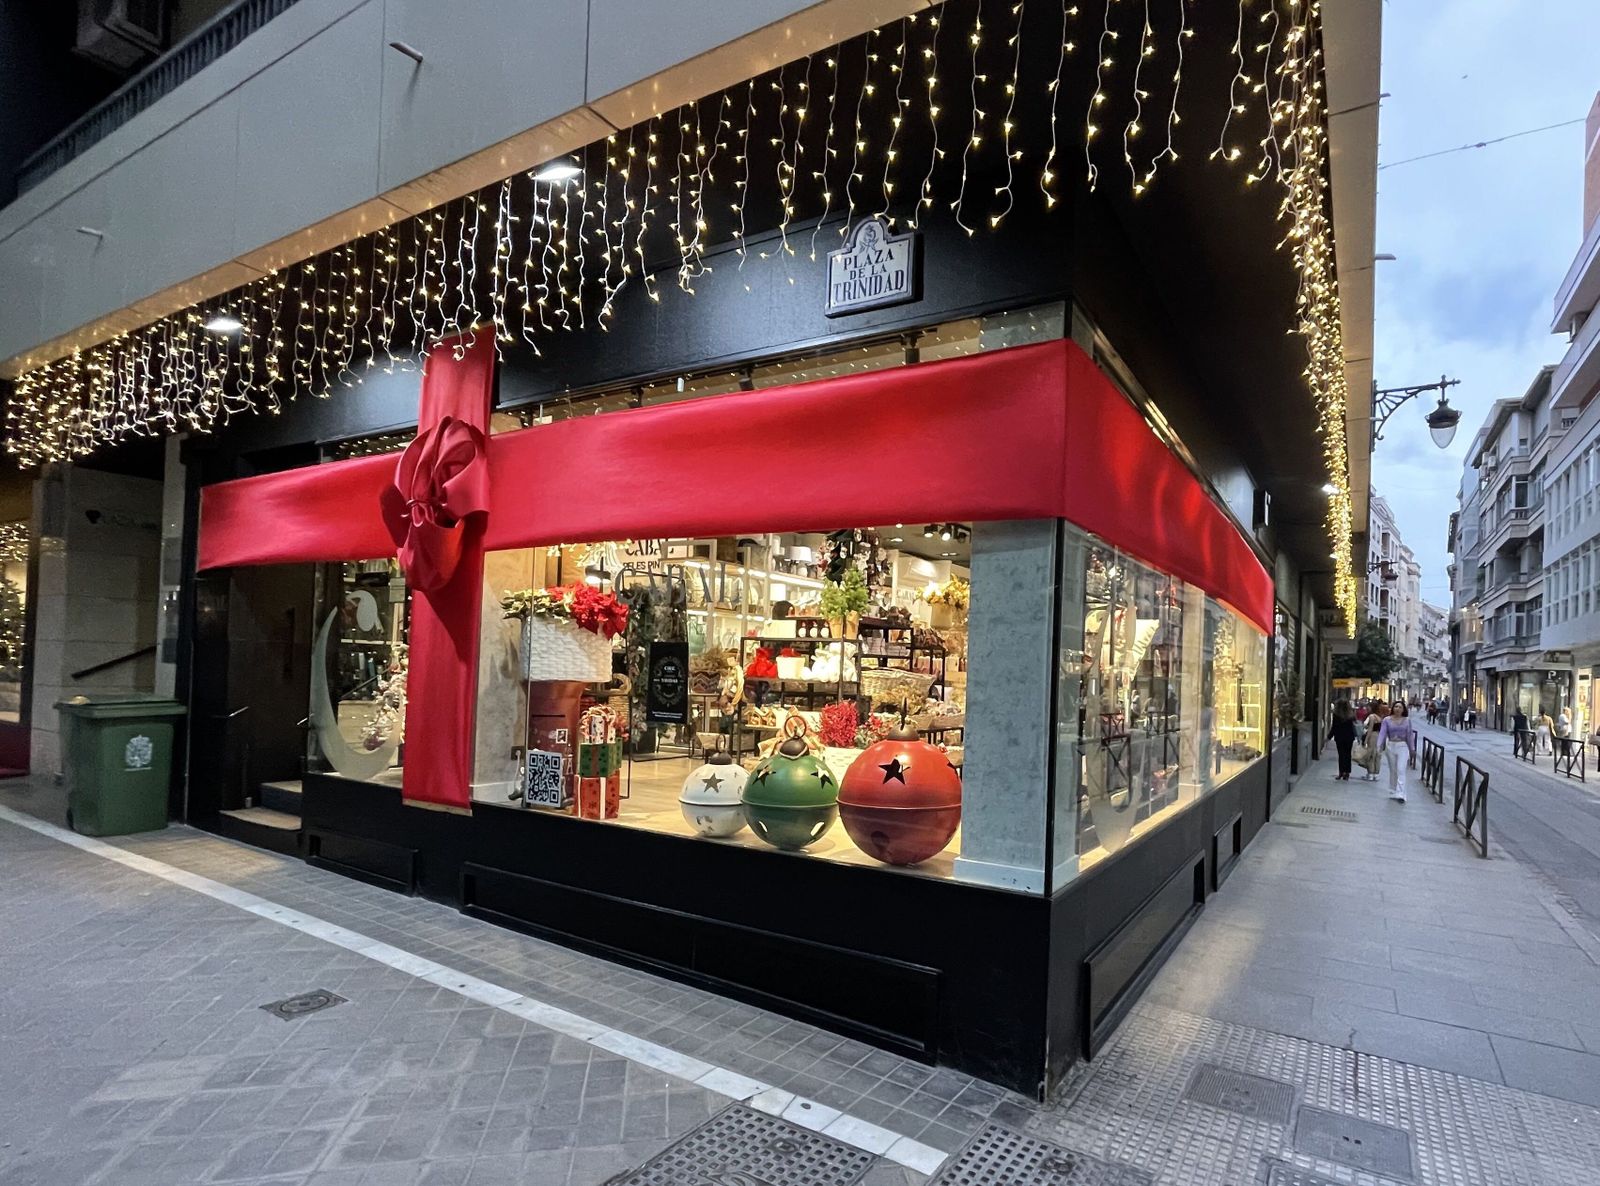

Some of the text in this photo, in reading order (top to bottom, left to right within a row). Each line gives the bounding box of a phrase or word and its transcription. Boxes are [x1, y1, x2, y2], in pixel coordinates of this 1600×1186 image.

[843, 248, 894, 271] PLAZA
[849, 264, 887, 280] DE LA
[833, 269, 905, 303] TRINIDAD
